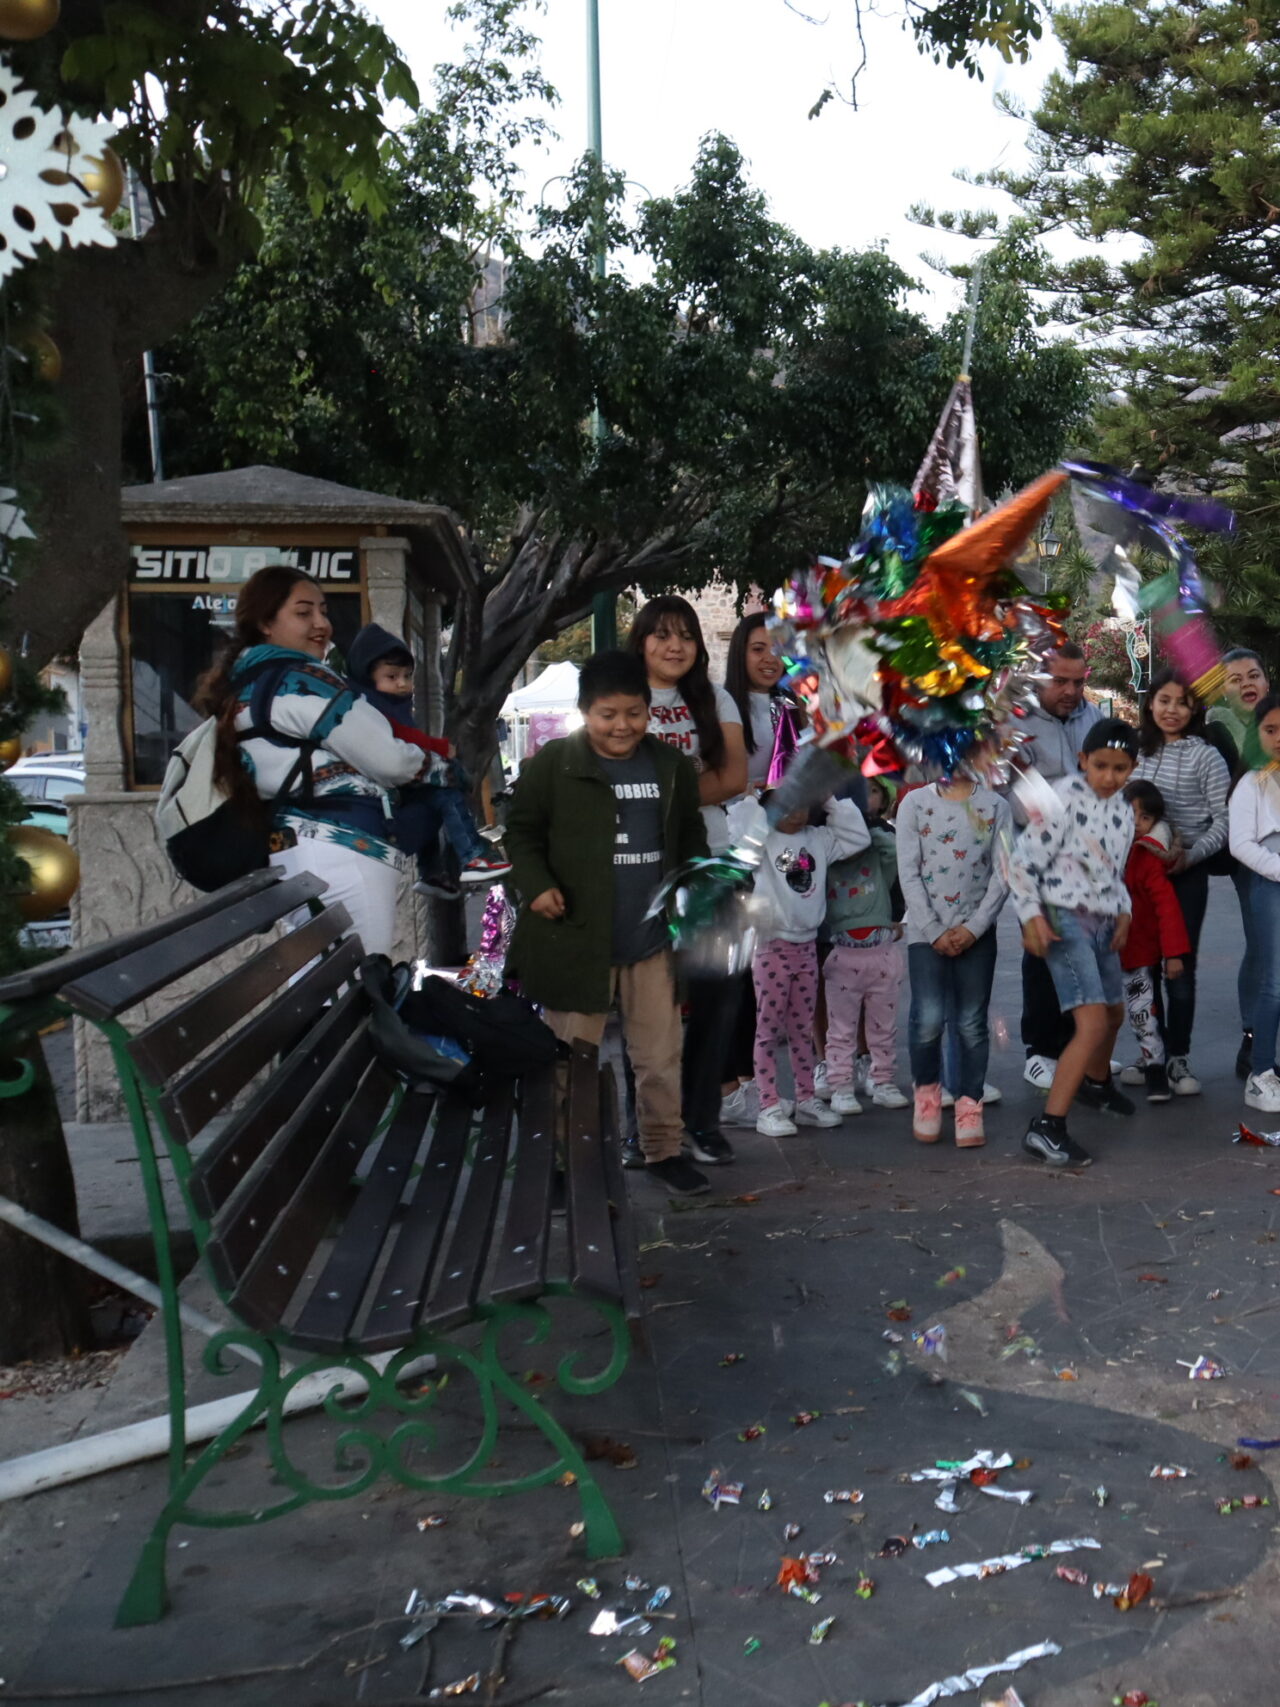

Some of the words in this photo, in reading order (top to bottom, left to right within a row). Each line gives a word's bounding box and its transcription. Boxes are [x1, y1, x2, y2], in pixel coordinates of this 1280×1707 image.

[136, 550, 232, 578] SITIO
[610, 783, 660, 799] OBBIES
[613, 853, 641, 865] ETTING
